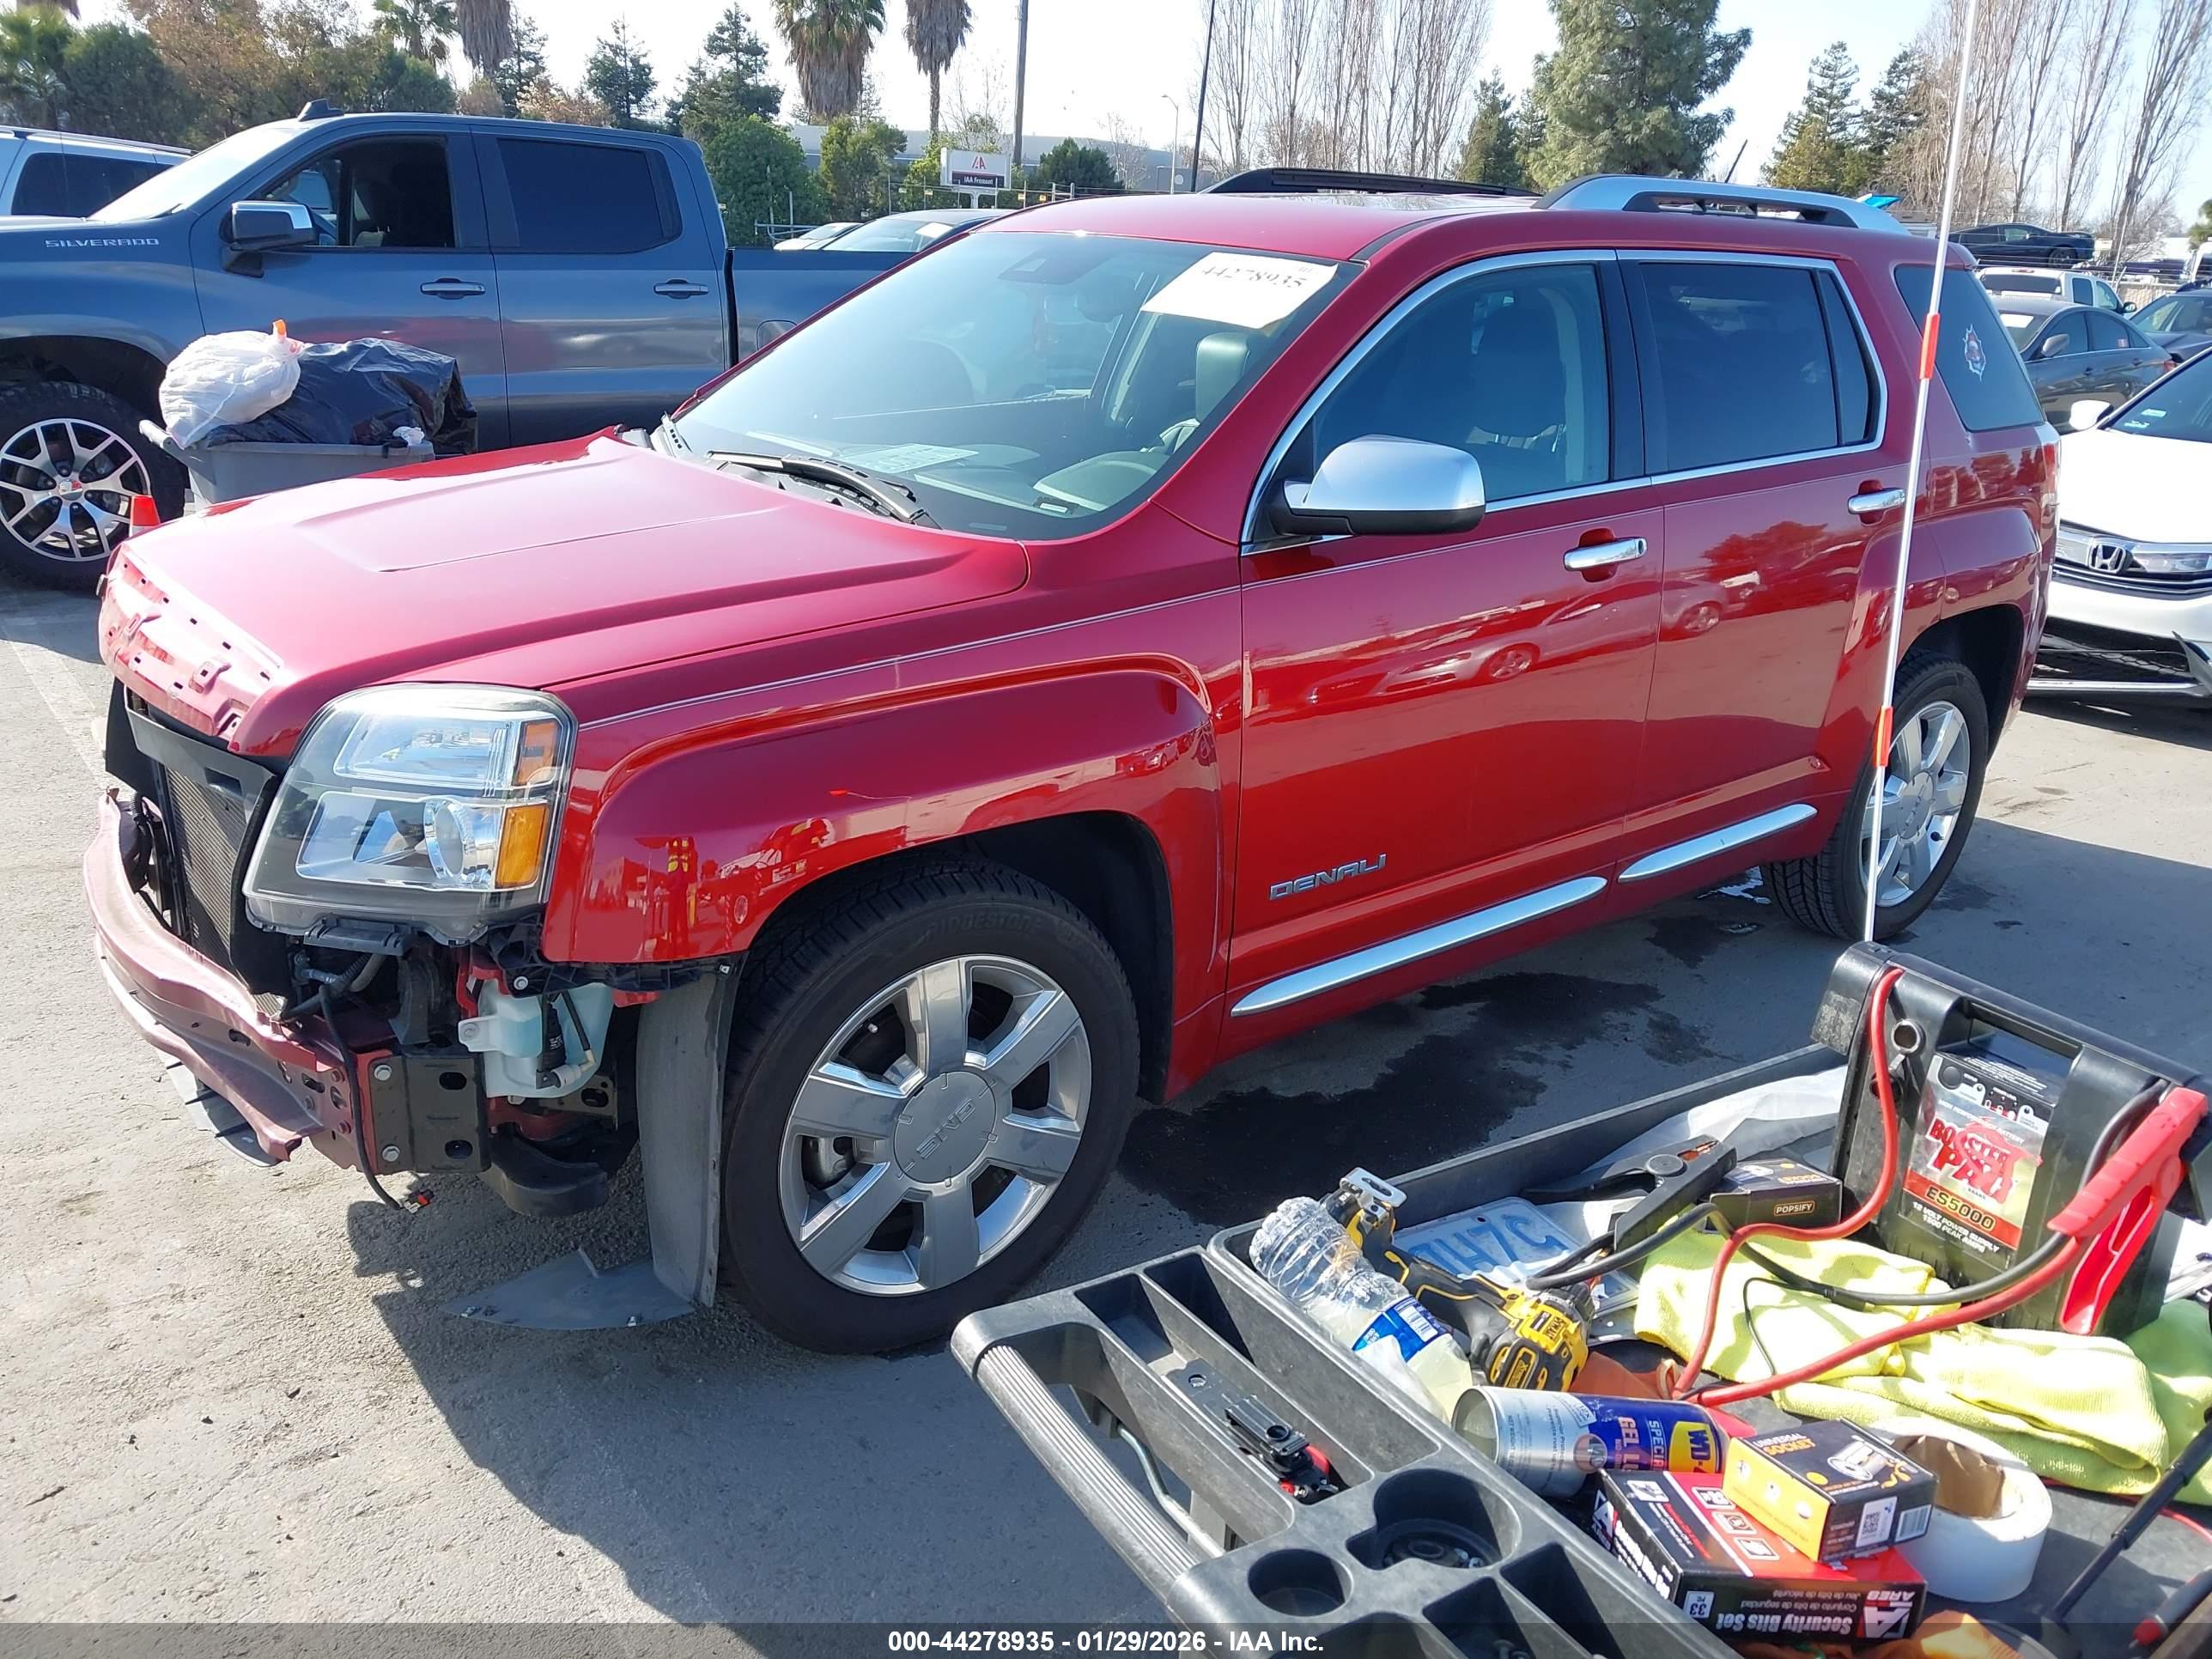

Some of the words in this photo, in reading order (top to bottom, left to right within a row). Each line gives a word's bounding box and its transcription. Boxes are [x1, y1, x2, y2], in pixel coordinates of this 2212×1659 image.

[963, 175, 973, 184] IAA
[974, 175, 994, 185] Fremont
[45, 238, 159, 248] SILVERADO
[1270, 854, 1387, 900] DENALI
[916, 1099, 975, 1159] GMC
[1776, 1203, 1813, 1214] POPSIFY
[1925, 1186, 1995, 1230] ES5000
[1923, 1206, 1942, 1220] VOLT
[1941, 1218, 1969, 1236] POWER
[1969, 1232, 2000, 1253] SUPPLY
[1942, 1224, 1962, 1240] PEAK
[1961, 1237, 1985, 1253] AMPS
[1618, 1417, 1639, 1448] GEL
[1649, 1420, 1665, 1471] SPECIA
[1763, 1438, 1816, 1456] SOCKET
[1741, 1599, 1780, 1609] seguridad
[1781, 1600, 1792, 1609] de
[1867, 1590, 1916, 1601] ARES
[1690, 1602, 1707, 1616] 33
[1809, 1601, 1820, 1611] de
[1821, 1601, 1857, 1613] Conjunto
[1716, 1613, 1745, 1632] Set
[1747, 1613, 1782, 1632] Bits
[1782, 1613, 1853, 1635] Security
